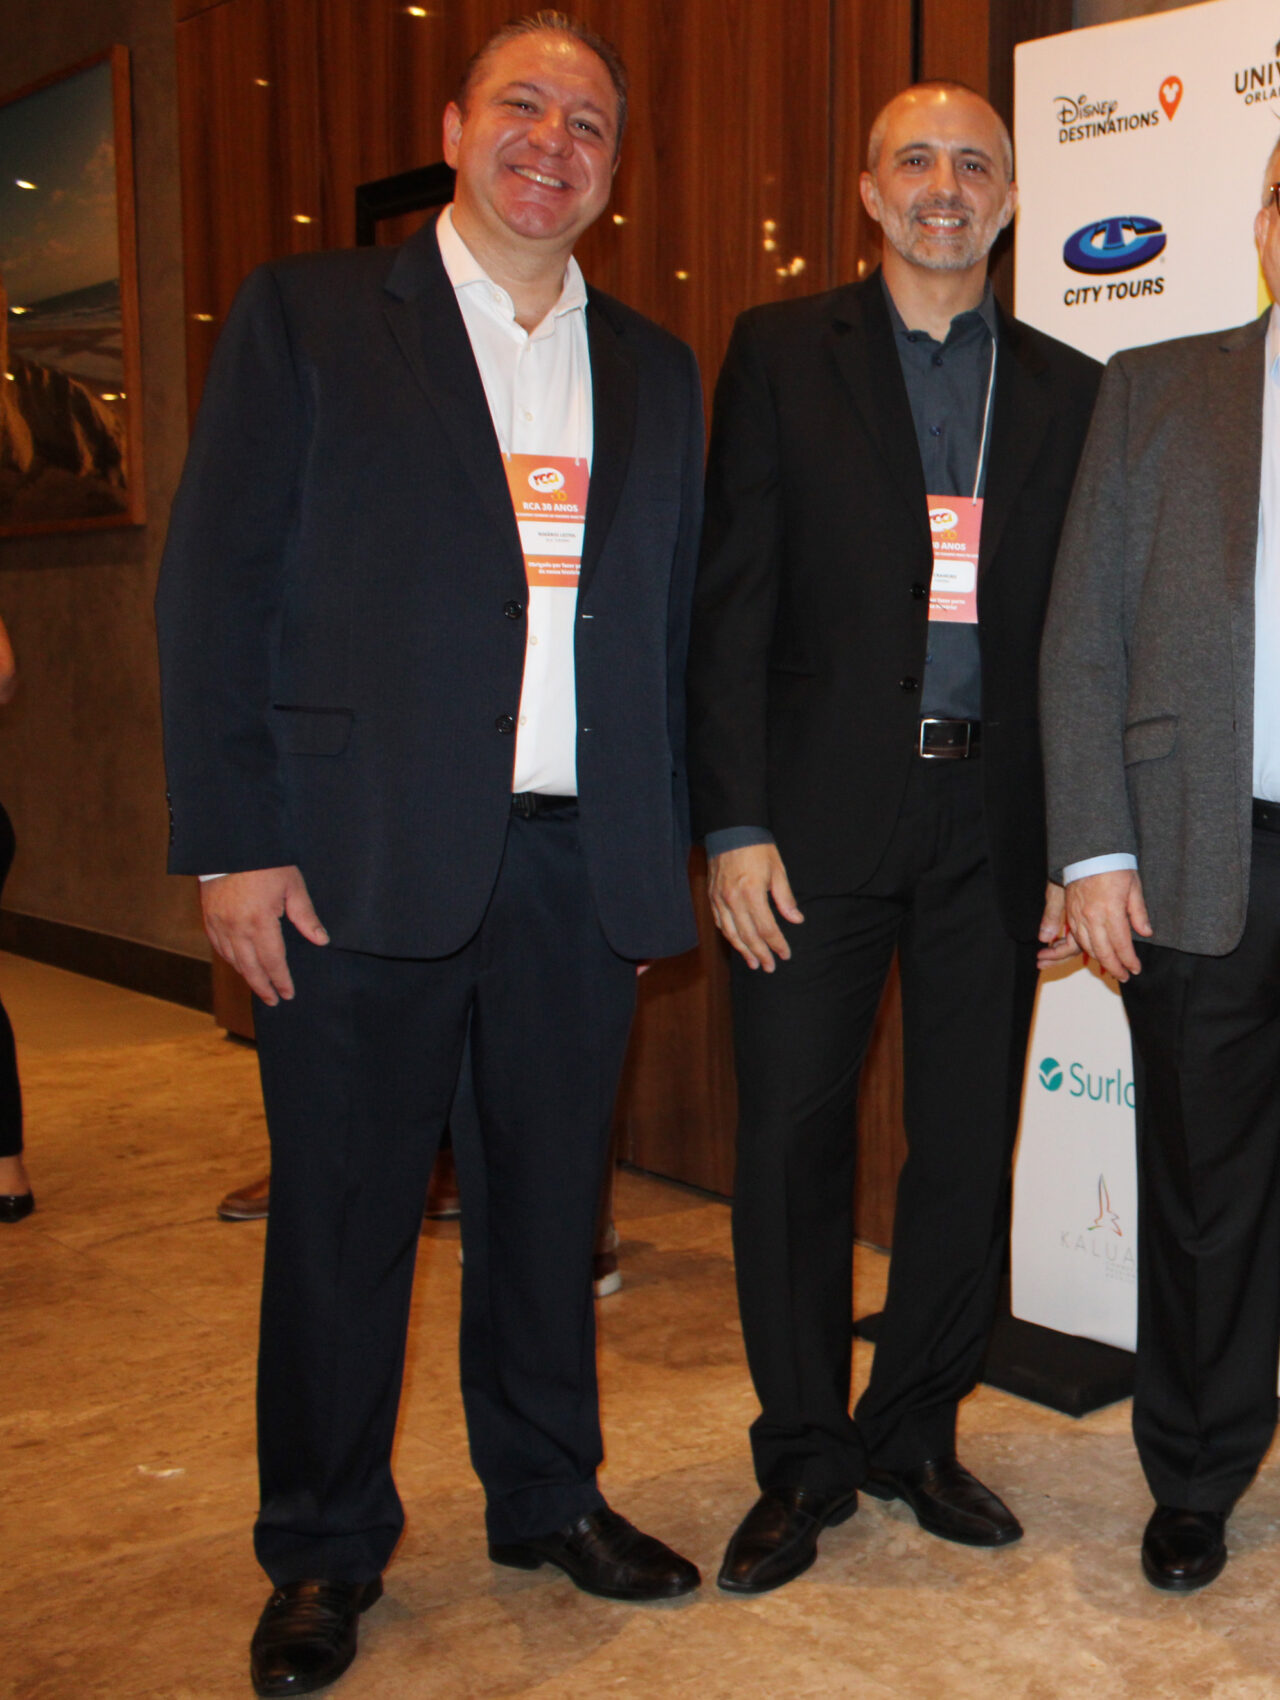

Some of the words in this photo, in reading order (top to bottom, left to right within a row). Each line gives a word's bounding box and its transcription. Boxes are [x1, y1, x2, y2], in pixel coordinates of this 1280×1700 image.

[1059, 110, 1159, 143] DESTINATIONS
[1063, 286, 1103, 306] CITY
[1106, 277, 1165, 300] TOURS
[523, 502, 541, 511] RCA
[554, 503, 579, 512] ANOS
[941, 542, 966, 551] ANOS
